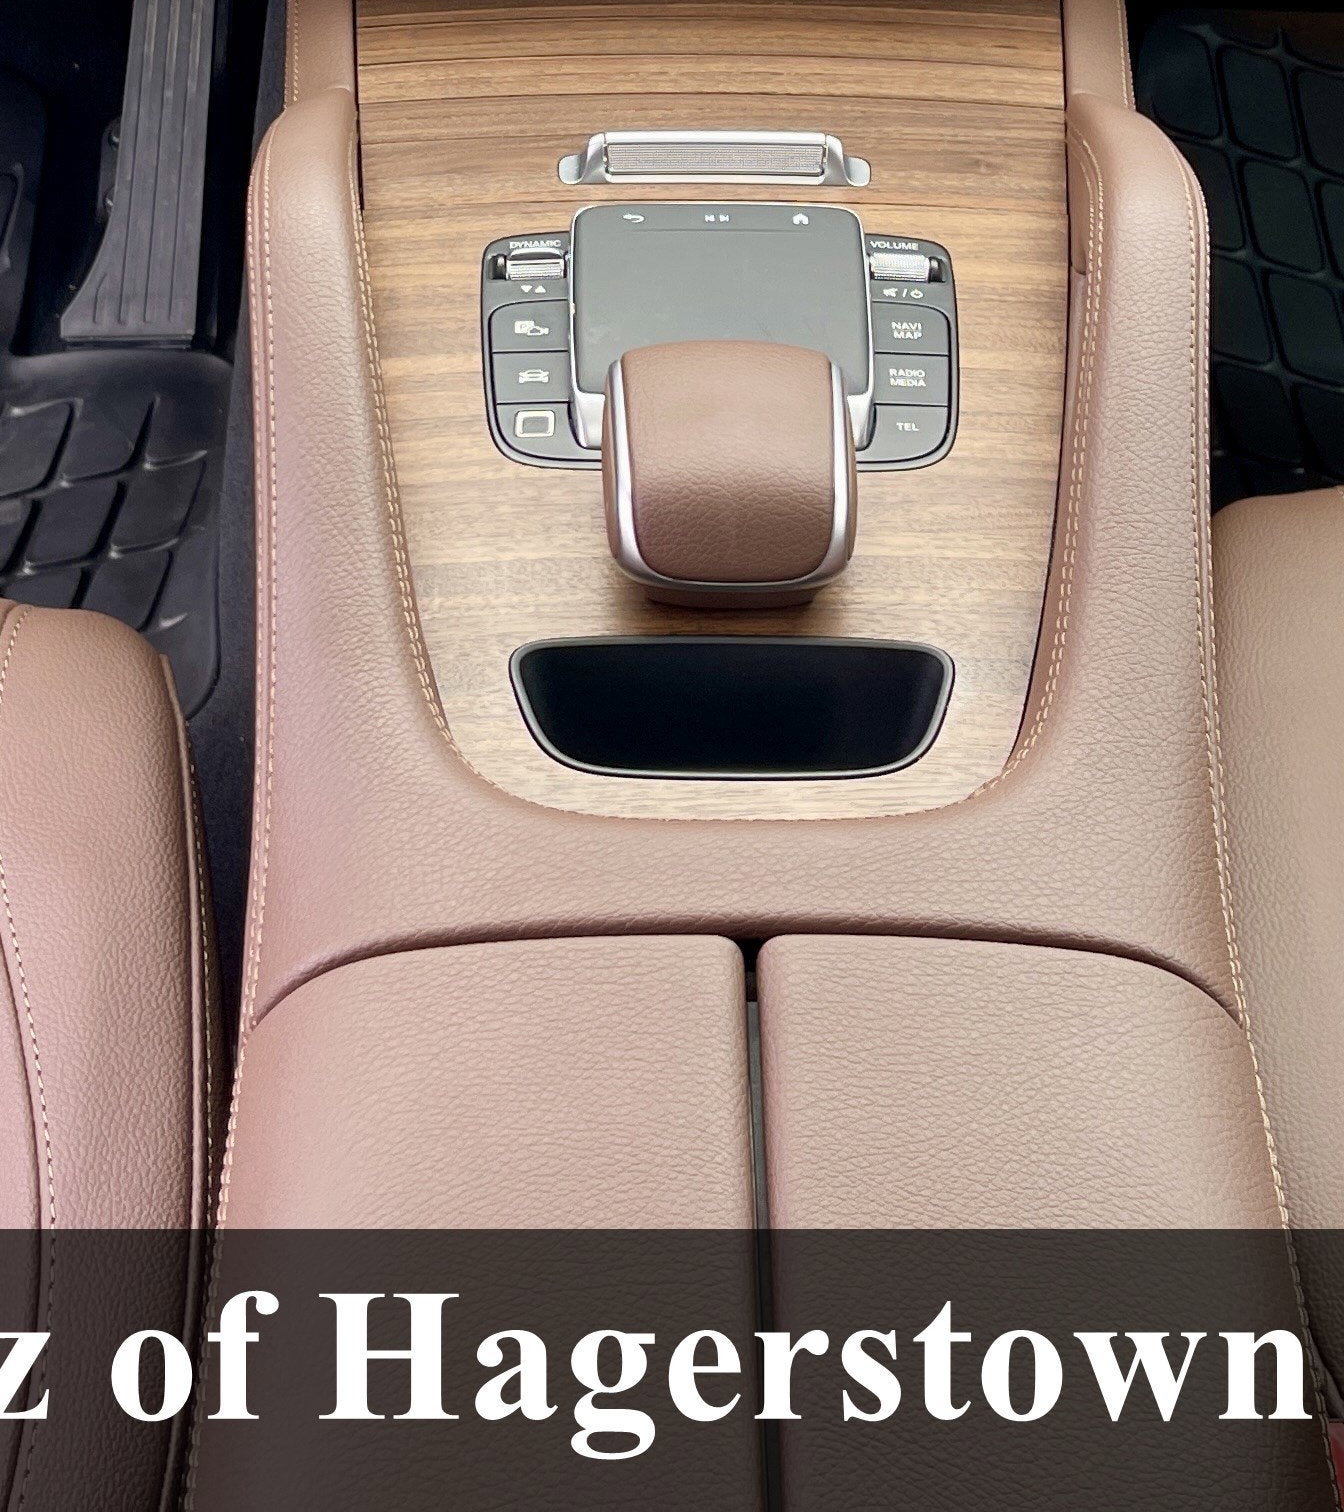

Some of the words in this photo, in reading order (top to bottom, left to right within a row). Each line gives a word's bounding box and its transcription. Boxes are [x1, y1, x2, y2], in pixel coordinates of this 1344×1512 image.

[509, 238, 562, 249] DYNAMIC
[869, 240, 919, 251] VOLUME
[891, 321, 922, 332] NAVI
[893, 330, 922, 340] MAP
[889, 368, 926, 378] RADIO
[889, 377, 927, 387] MEDIA
[896, 421, 919, 432] TEL
